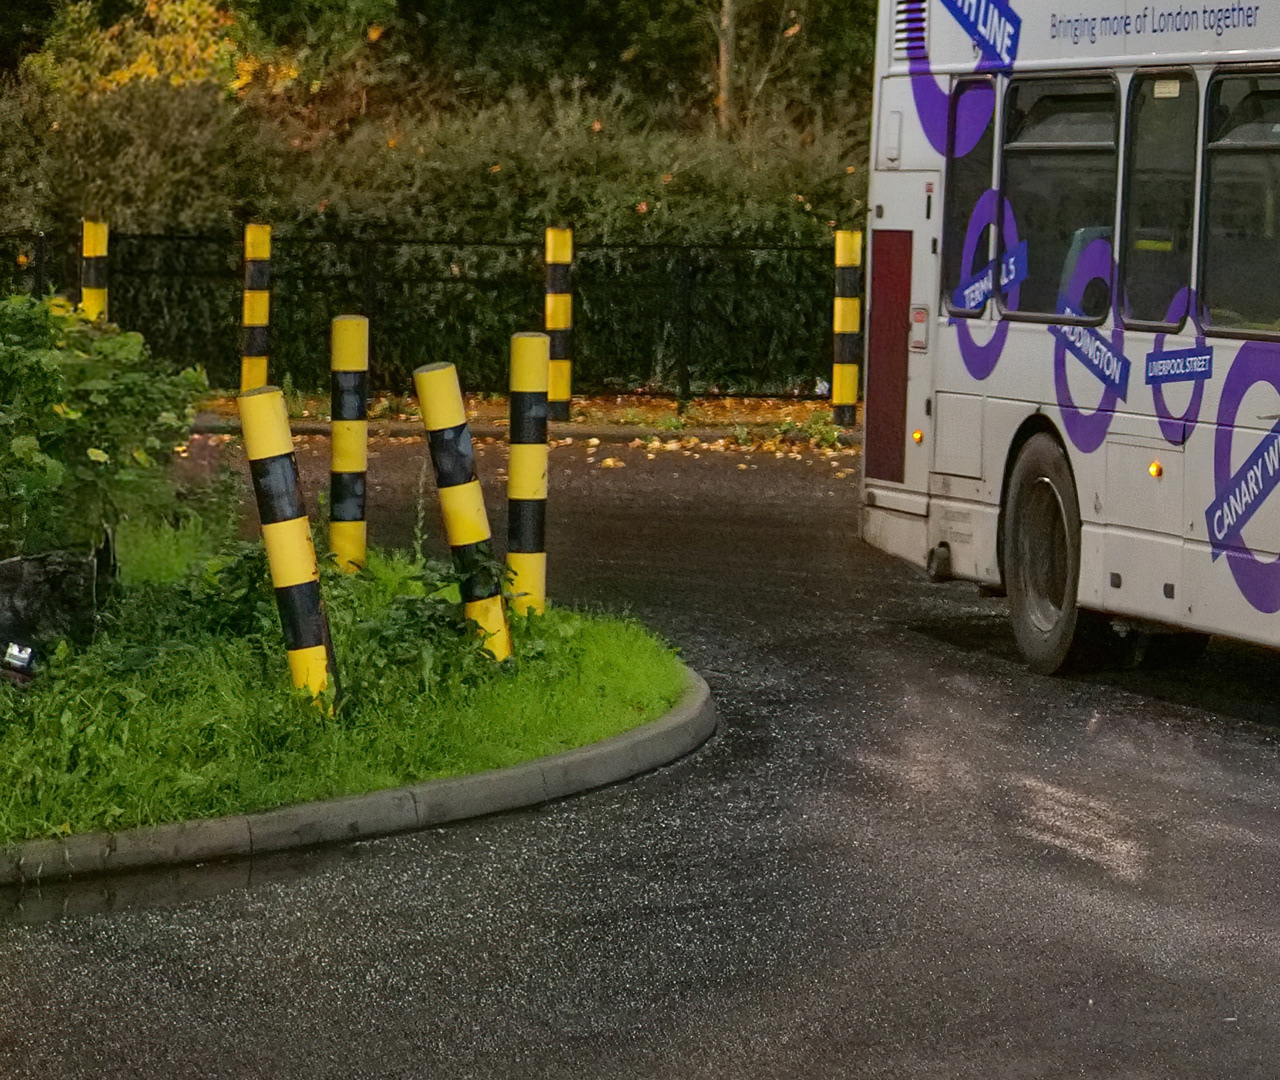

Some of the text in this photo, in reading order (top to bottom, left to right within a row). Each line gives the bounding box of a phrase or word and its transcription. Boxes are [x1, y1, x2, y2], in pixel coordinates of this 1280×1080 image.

[1050, 0, 1260, 44] Bringing more of London together
[1148, 355, 1211, 377] LIVERPOOL STREET
[1213, 458, 1263, 540] CANARY
